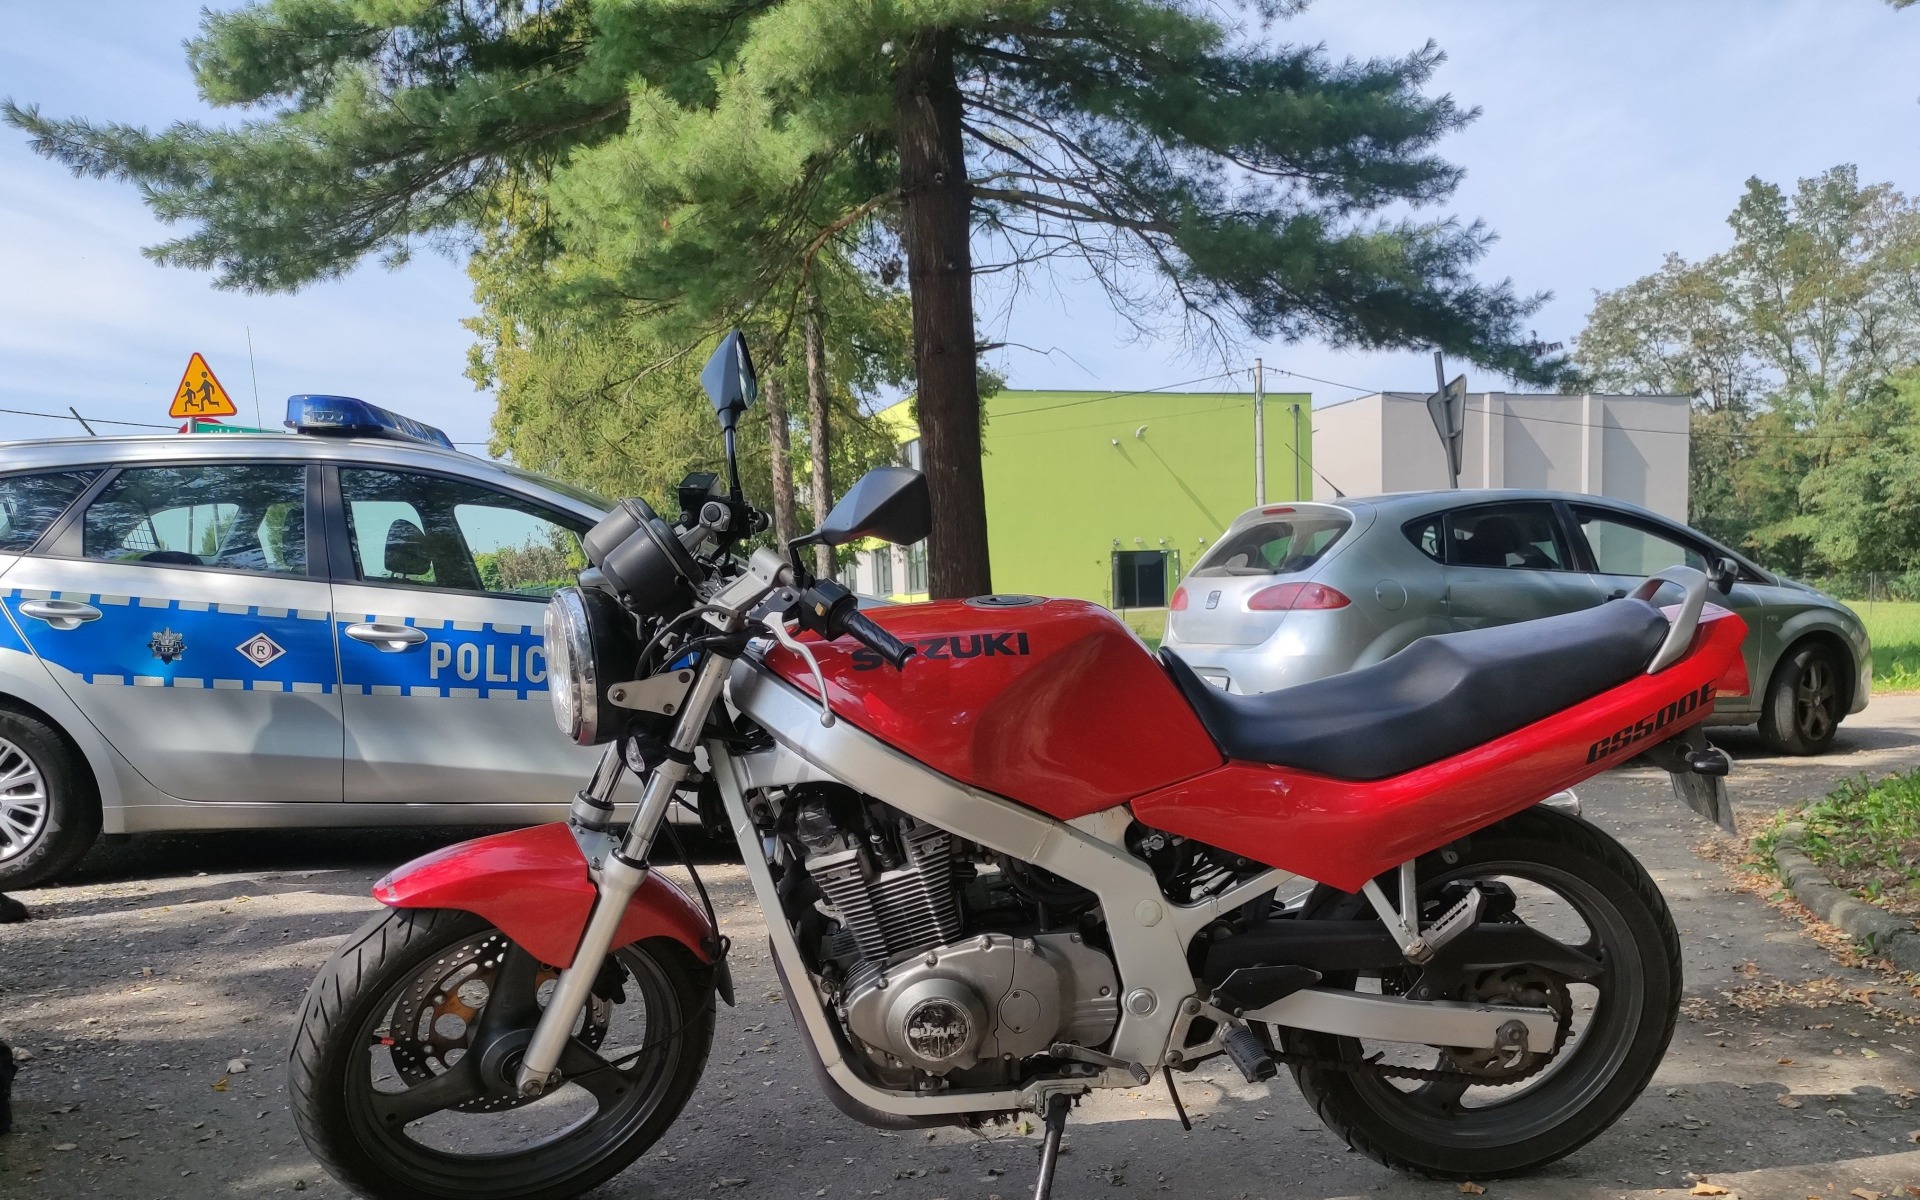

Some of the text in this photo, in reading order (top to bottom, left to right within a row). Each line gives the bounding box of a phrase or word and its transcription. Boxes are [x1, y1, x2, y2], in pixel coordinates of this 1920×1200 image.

[256, 645, 266, 655] R
[851, 632, 1030, 672] SZUKI
[1585, 678, 1718, 765] GS500E
